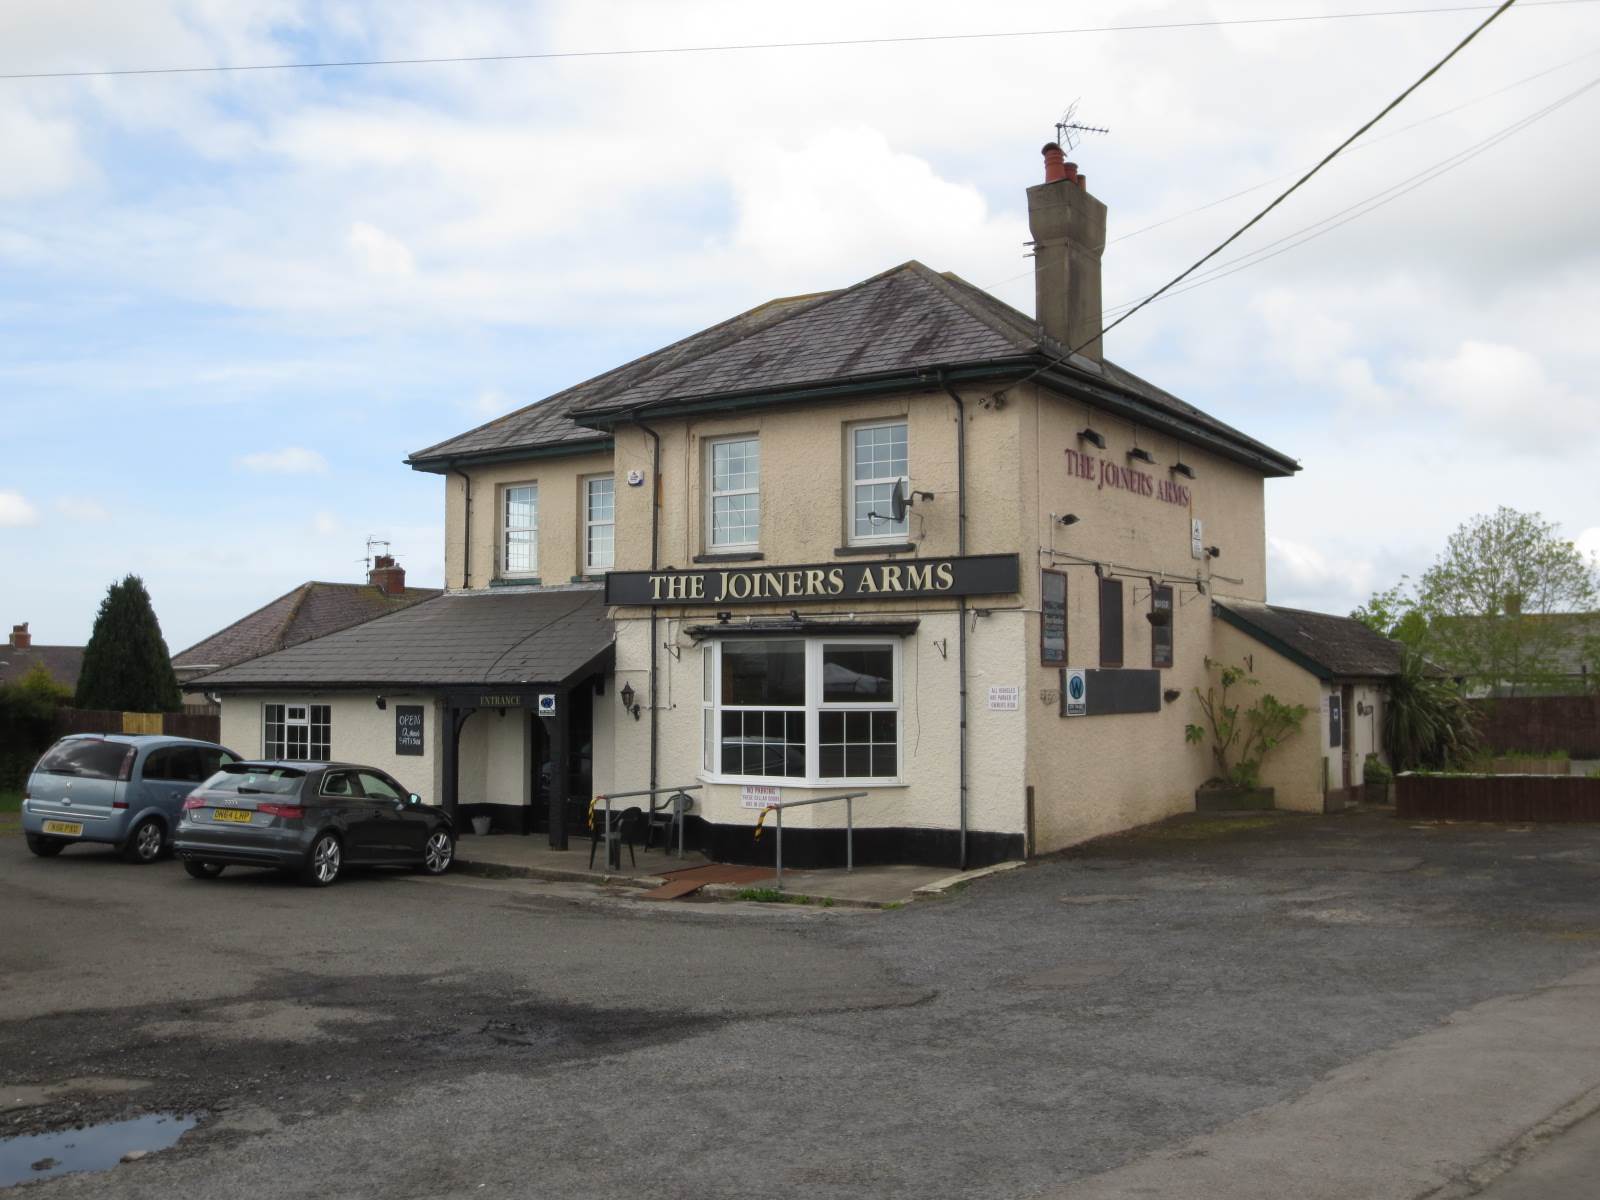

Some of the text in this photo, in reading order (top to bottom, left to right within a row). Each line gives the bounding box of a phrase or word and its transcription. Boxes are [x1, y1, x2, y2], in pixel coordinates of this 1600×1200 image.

[1064, 448, 1189, 507] THE JOINERS ARMS
[649, 562, 954, 602] THE JOINERS ARMS
[480, 695, 521, 705] ENTRANCE
[399, 714, 421, 726] OPEN
[746, 786, 776, 795] NO PARKING
